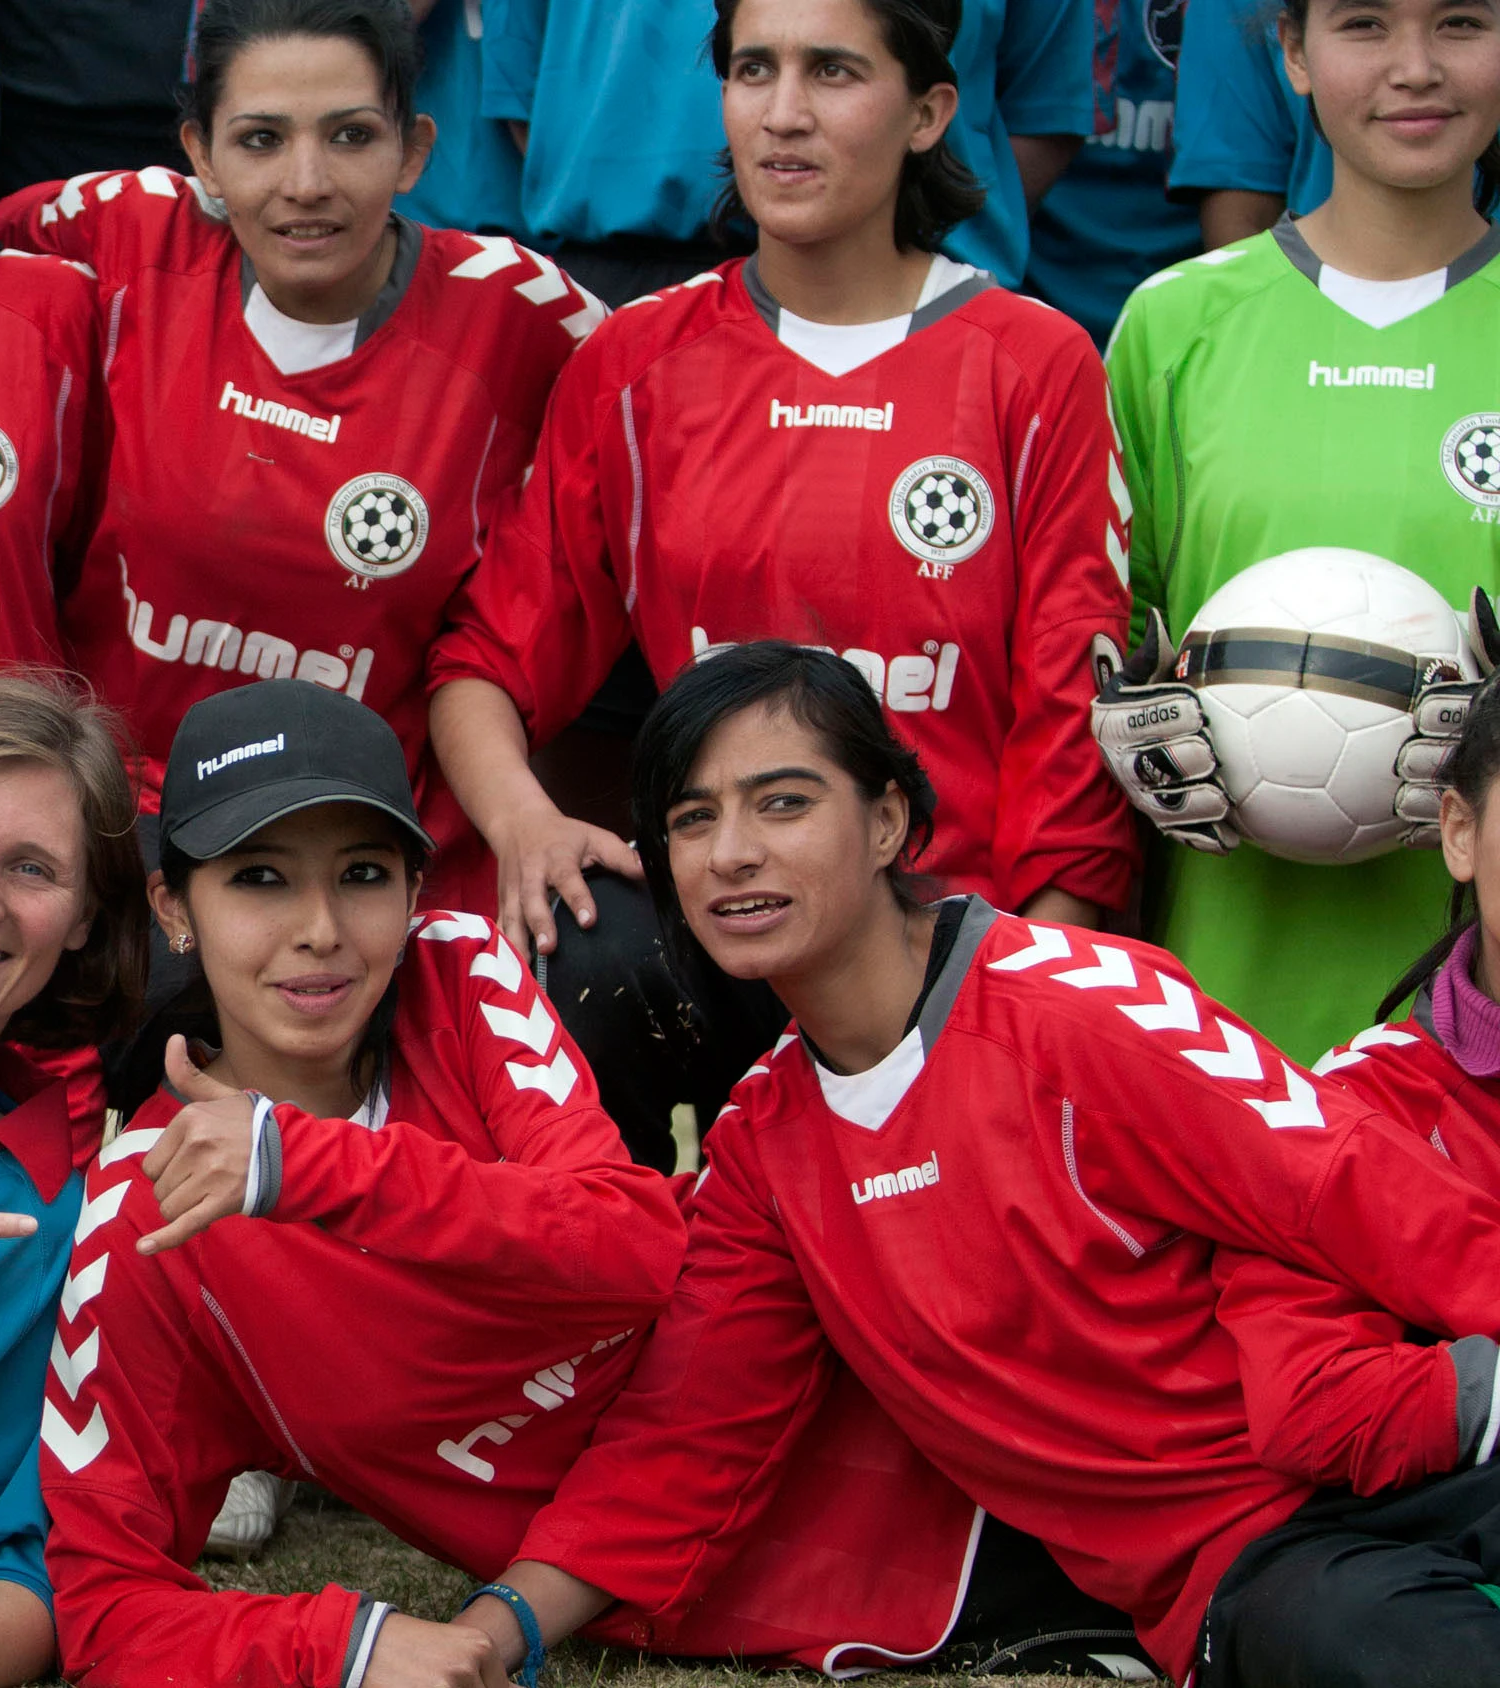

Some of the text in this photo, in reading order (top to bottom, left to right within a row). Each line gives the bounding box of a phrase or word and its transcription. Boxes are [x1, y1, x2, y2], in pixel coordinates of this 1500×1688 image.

[1308, 360, 1435, 390] hummel
[218, 381, 341, 444] hummel
[770, 398, 894, 431] hummel
[330, 476, 428, 548] Afghanistan Football Federation
[893, 459, 991, 531] Afghanistan Football Federation
[1471, 506, 1500, 525] AF
[917, 560, 955, 580] AFF
[1127, 705, 1180, 729] adidas
[197, 733, 284, 780] hummel
[851, 1150, 940, 1205] ummel
